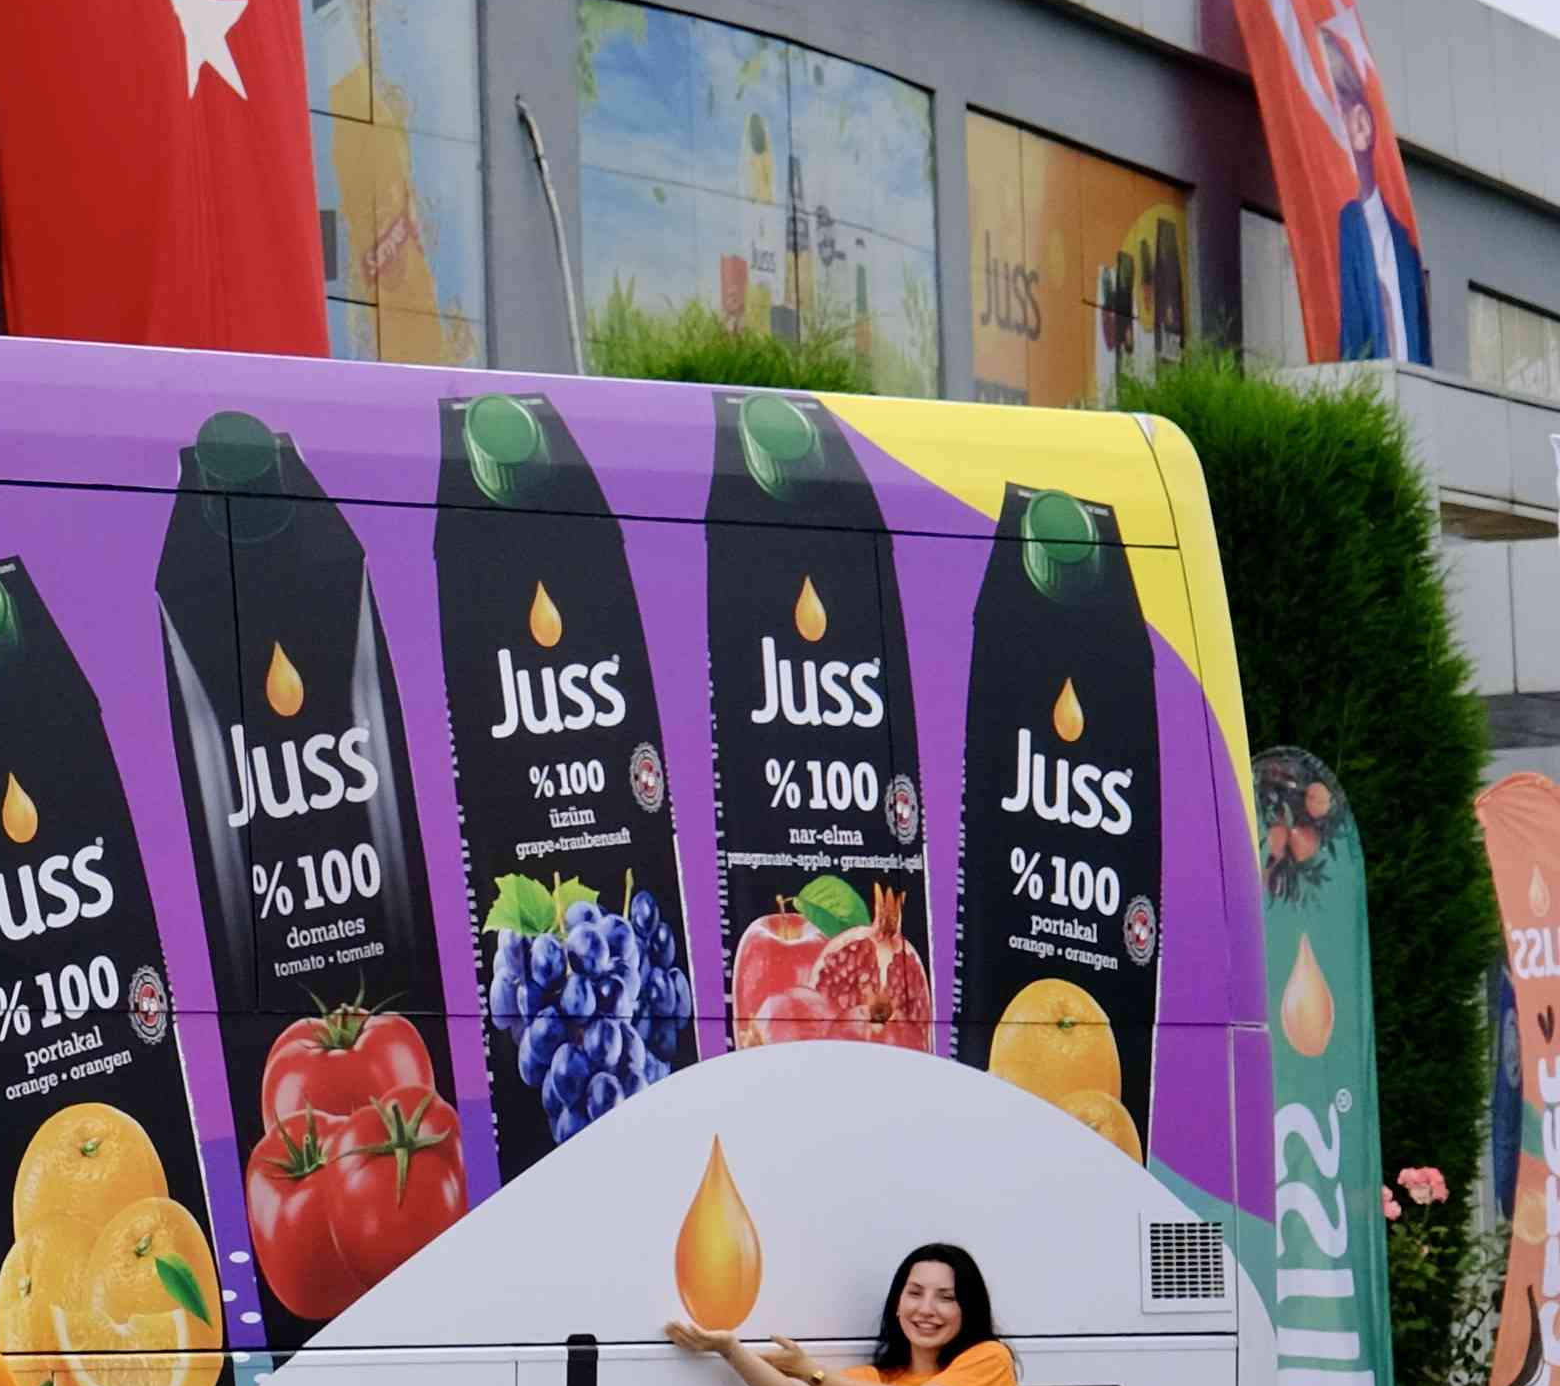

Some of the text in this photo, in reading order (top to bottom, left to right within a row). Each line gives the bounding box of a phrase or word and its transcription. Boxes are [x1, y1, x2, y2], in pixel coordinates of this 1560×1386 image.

[981, 229, 1041, 341] Juss
[491, 648, 626, 739] Juss
[751, 636, 884, 728] Juss
[228, 724, 379, 828] Juss
[529, 759, 606, 799] %100
[1001, 728, 1133, 835] Juss
[549, 806, 596, 828] üzüm
[789, 825, 864, 846] nar-elma
[286, 917, 366, 949] domates
[1031, 915, 1099, 943] portakal
[274, 941, 384, 976] tomato tomate
[1008, 935, 1119, 971] orange orangen
[24, 1025, 104, 1075] portakal
[5, 1049, 132, 1100] orange orangen
